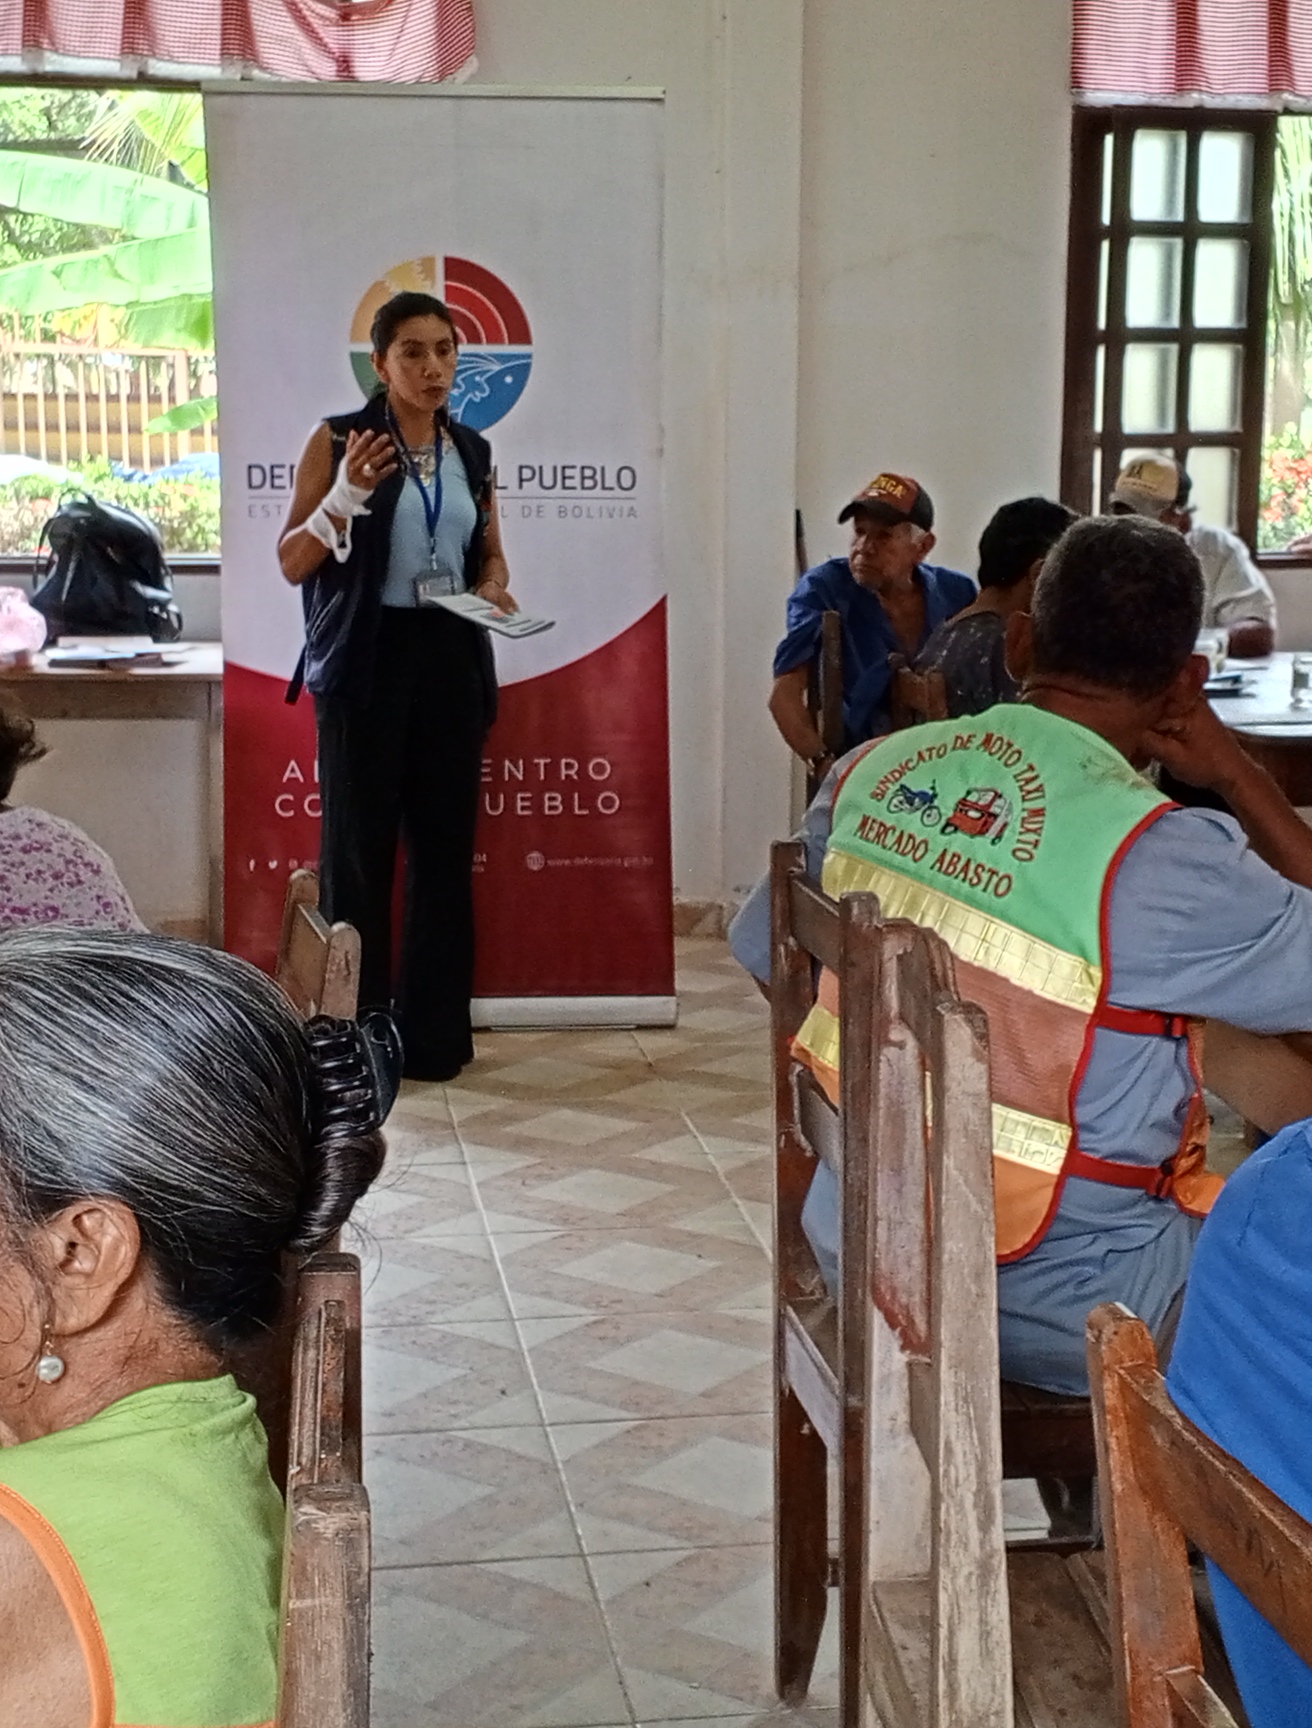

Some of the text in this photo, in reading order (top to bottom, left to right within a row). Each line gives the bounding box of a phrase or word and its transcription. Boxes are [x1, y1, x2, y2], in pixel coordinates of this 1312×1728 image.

[517, 465, 637, 491] PUEBLO
[521, 506, 545, 519] DE
[558, 505, 637, 519] BOLIVIA
[870, 731, 1046, 862] SINDICATO DE MOTO TAXI MIXTO
[856, 813, 1013, 898] MERCADO ABASTO
